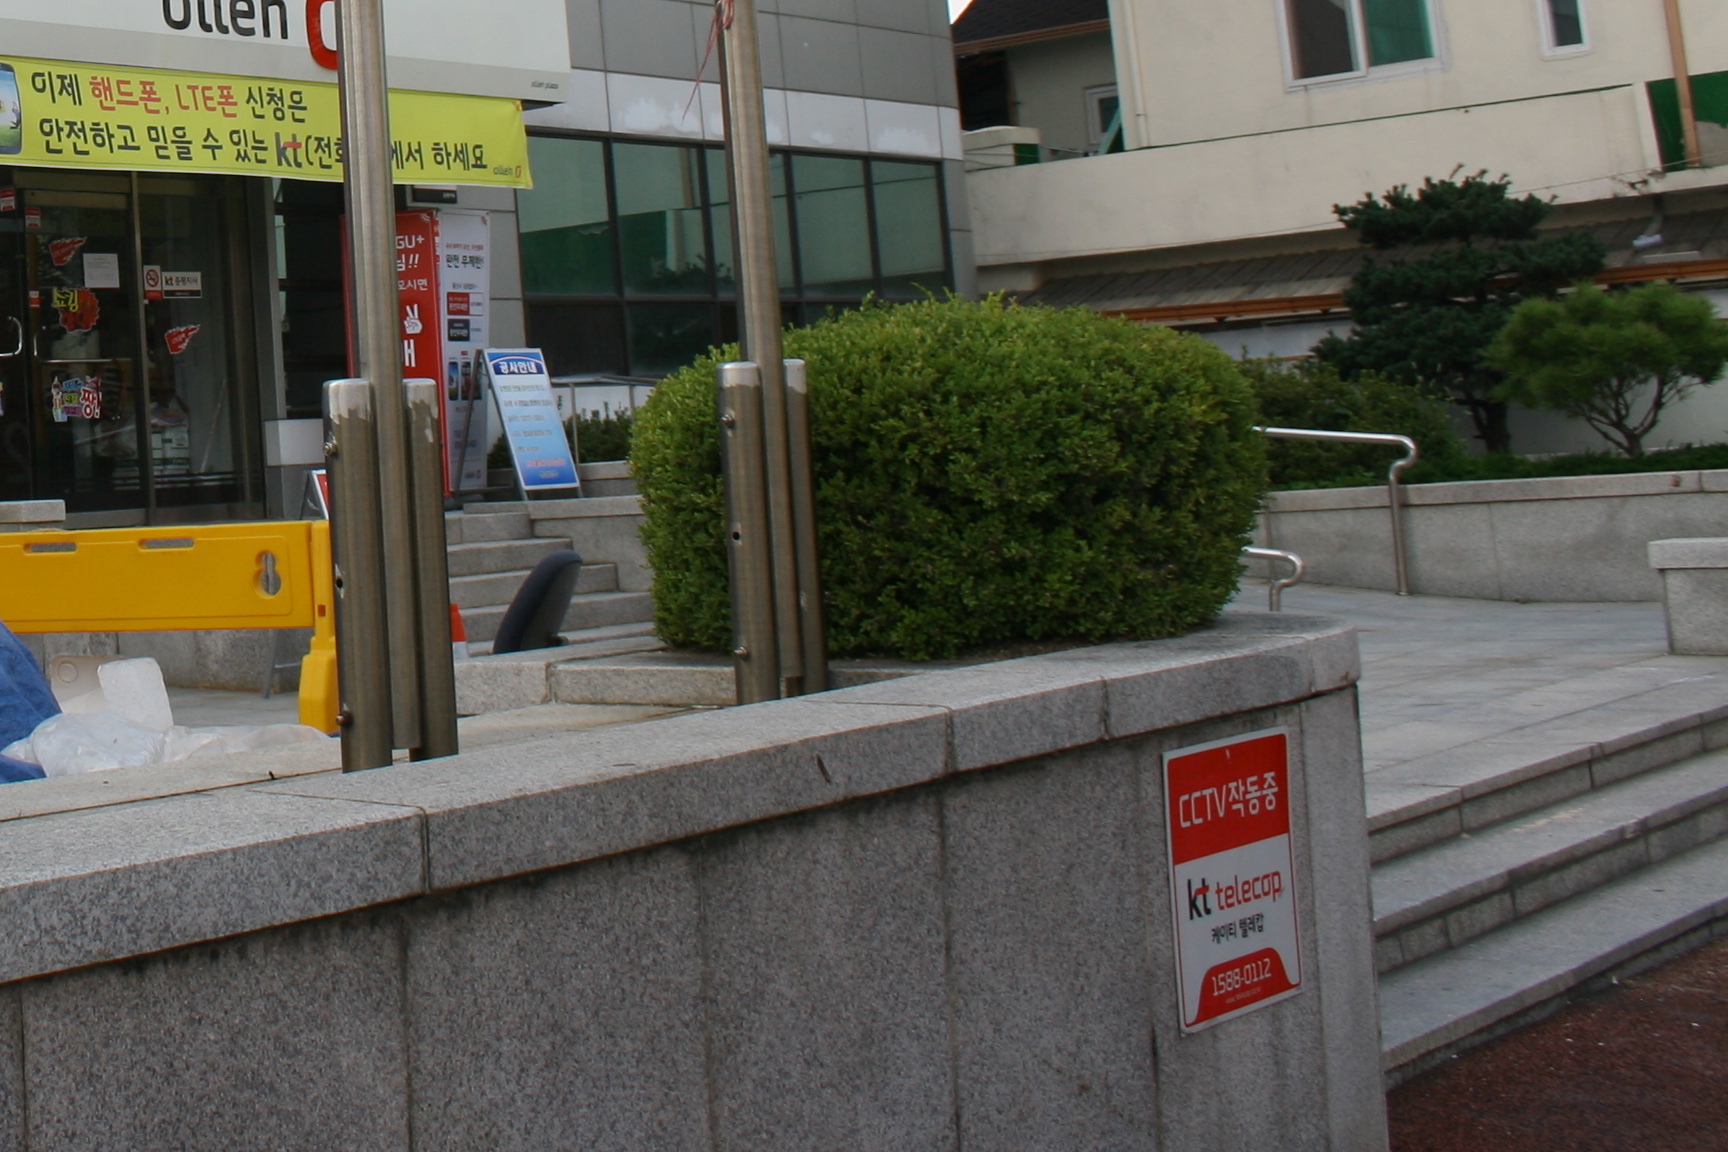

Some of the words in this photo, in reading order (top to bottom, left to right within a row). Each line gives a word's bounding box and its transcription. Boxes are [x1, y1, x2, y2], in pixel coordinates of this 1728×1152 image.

[31, 71, 82, 106] 이제
[89, 76, 170, 115] 핸드폰,
[175, 84, 238, 118] LTE폰
[245, 86, 307, 123] 신청은
[40, 118, 141, 156] 안전하고
[147, 125, 193, 161] 믿을
[202, 128, 224, 161] 수
[229, 128, 268, 164] 있는
[432, 141, 488, 171] 하세요
[397, 278, 428, 291] 오시면
[1178, 771, 1279, 829] CCTV작동중
[1187, 877, 1212, 920] kt
[1215, 870, 1283, 911] telecop
[1211, 958, 1272, 996] 1588-0112
